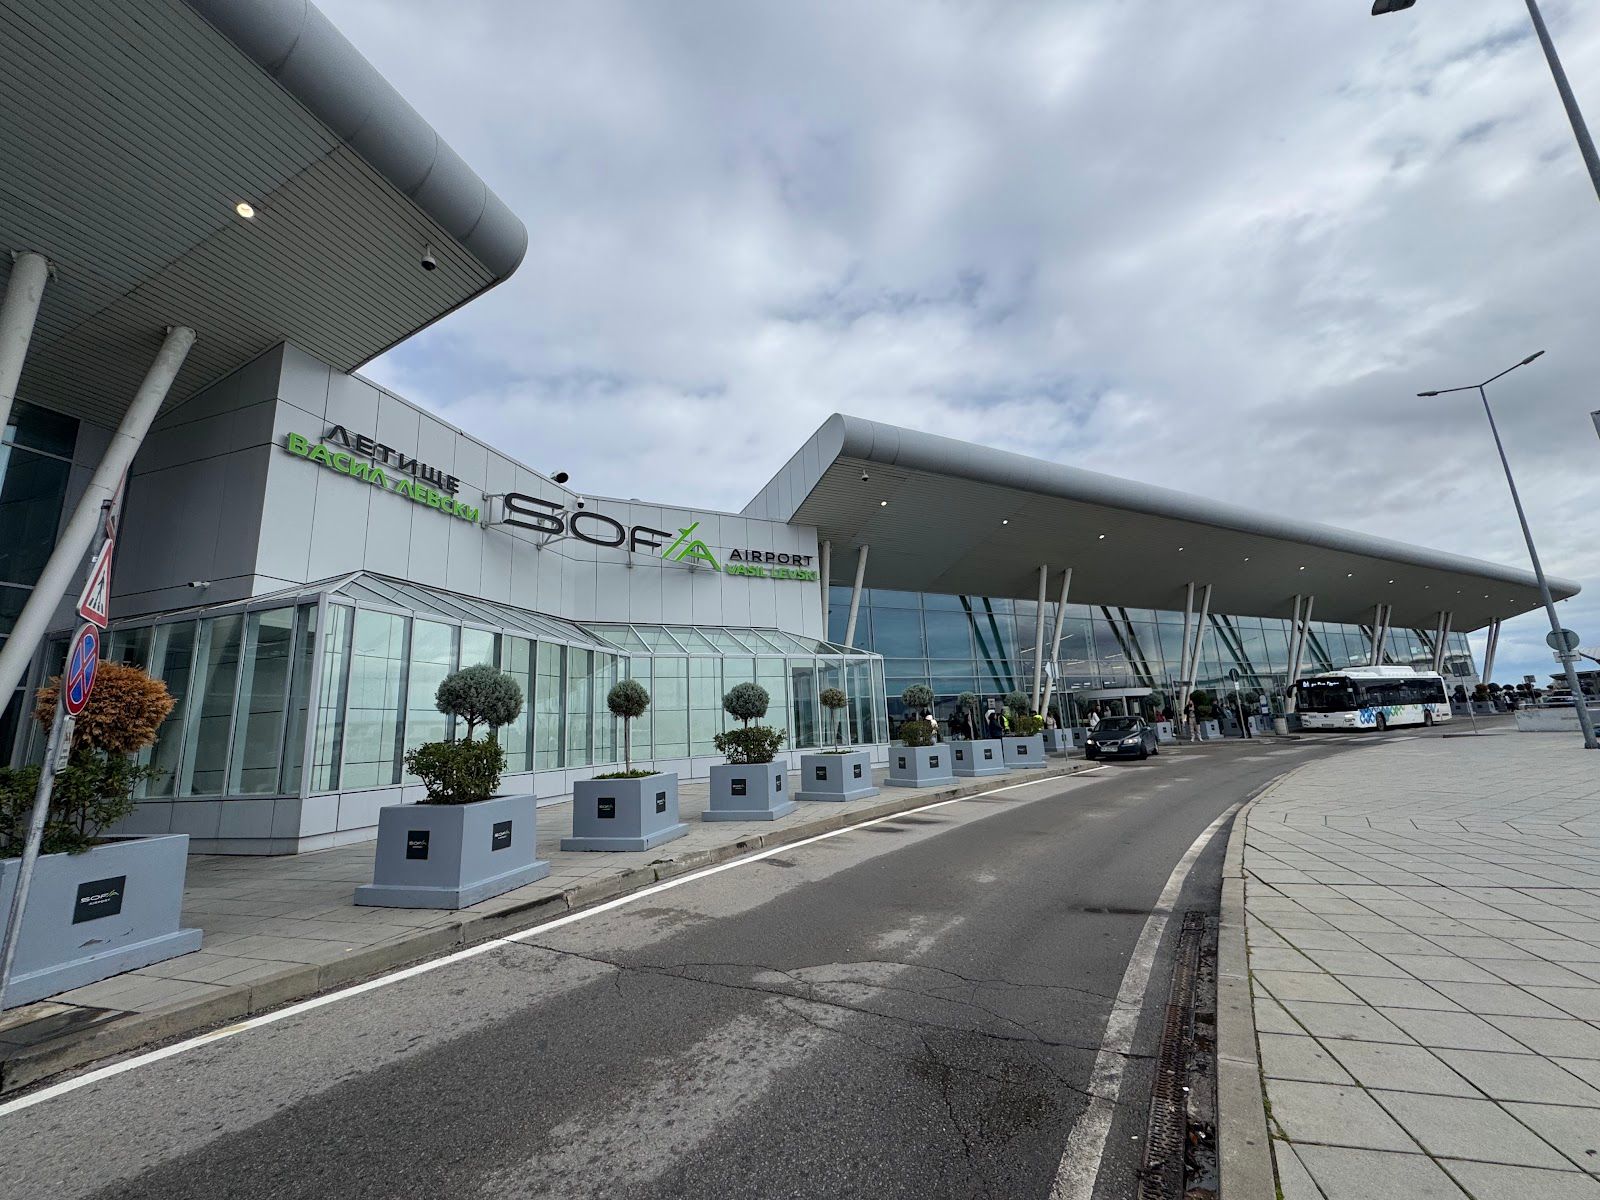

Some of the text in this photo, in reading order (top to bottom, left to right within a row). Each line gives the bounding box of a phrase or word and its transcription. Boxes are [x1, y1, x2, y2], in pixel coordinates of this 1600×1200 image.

[287, 432, 480, 523] ВАСИЛ ЛЕВСКИ
[324, 424, 460, 494] ЛЕТИЩЕ
[502, 492, 721, 572] SOFIA
[726, 564, 818, 581] VASIL LEVSKI
[730, 549, 813, 566] AIRPORT
[80, 889, 119, 904] SOFIA
